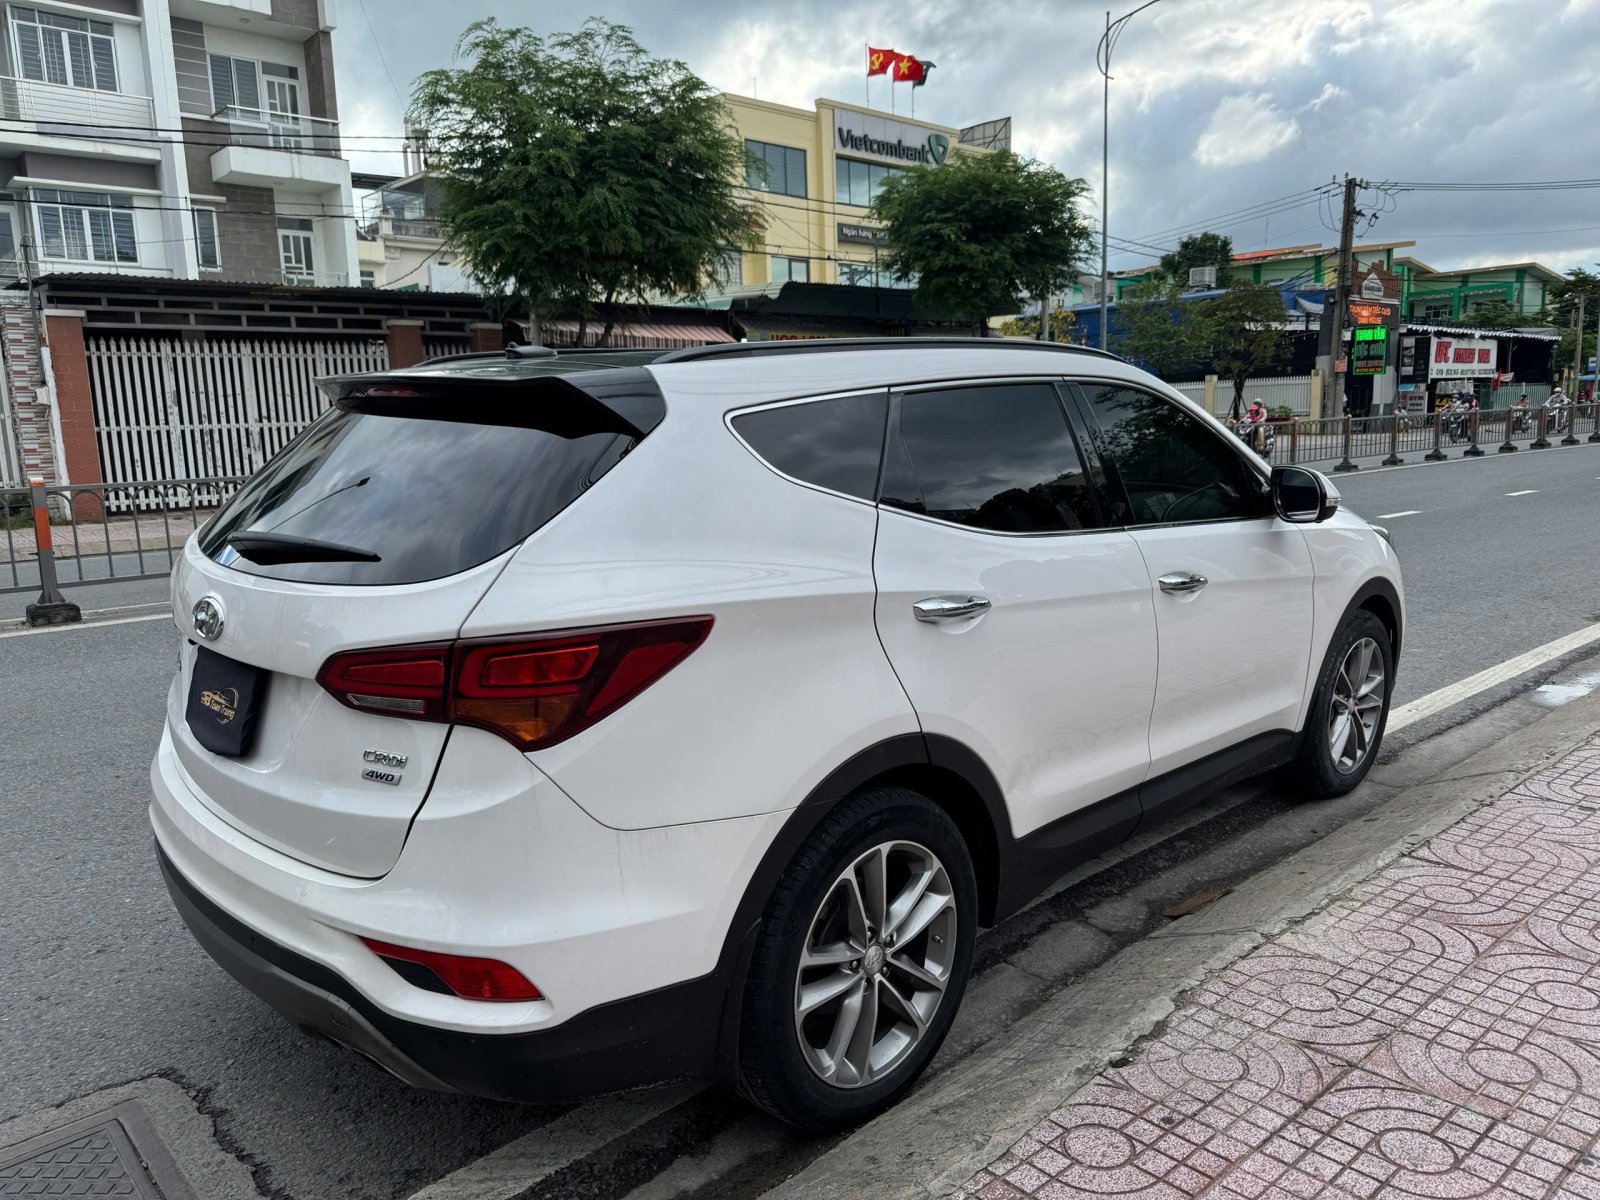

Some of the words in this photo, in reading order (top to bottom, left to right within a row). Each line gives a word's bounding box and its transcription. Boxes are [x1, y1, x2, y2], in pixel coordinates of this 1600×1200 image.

[838, 127, 931, 164] Vietcombank
[1435, 341, 1452, 363] UFC
[365, 770, 395, 782] 4WD
